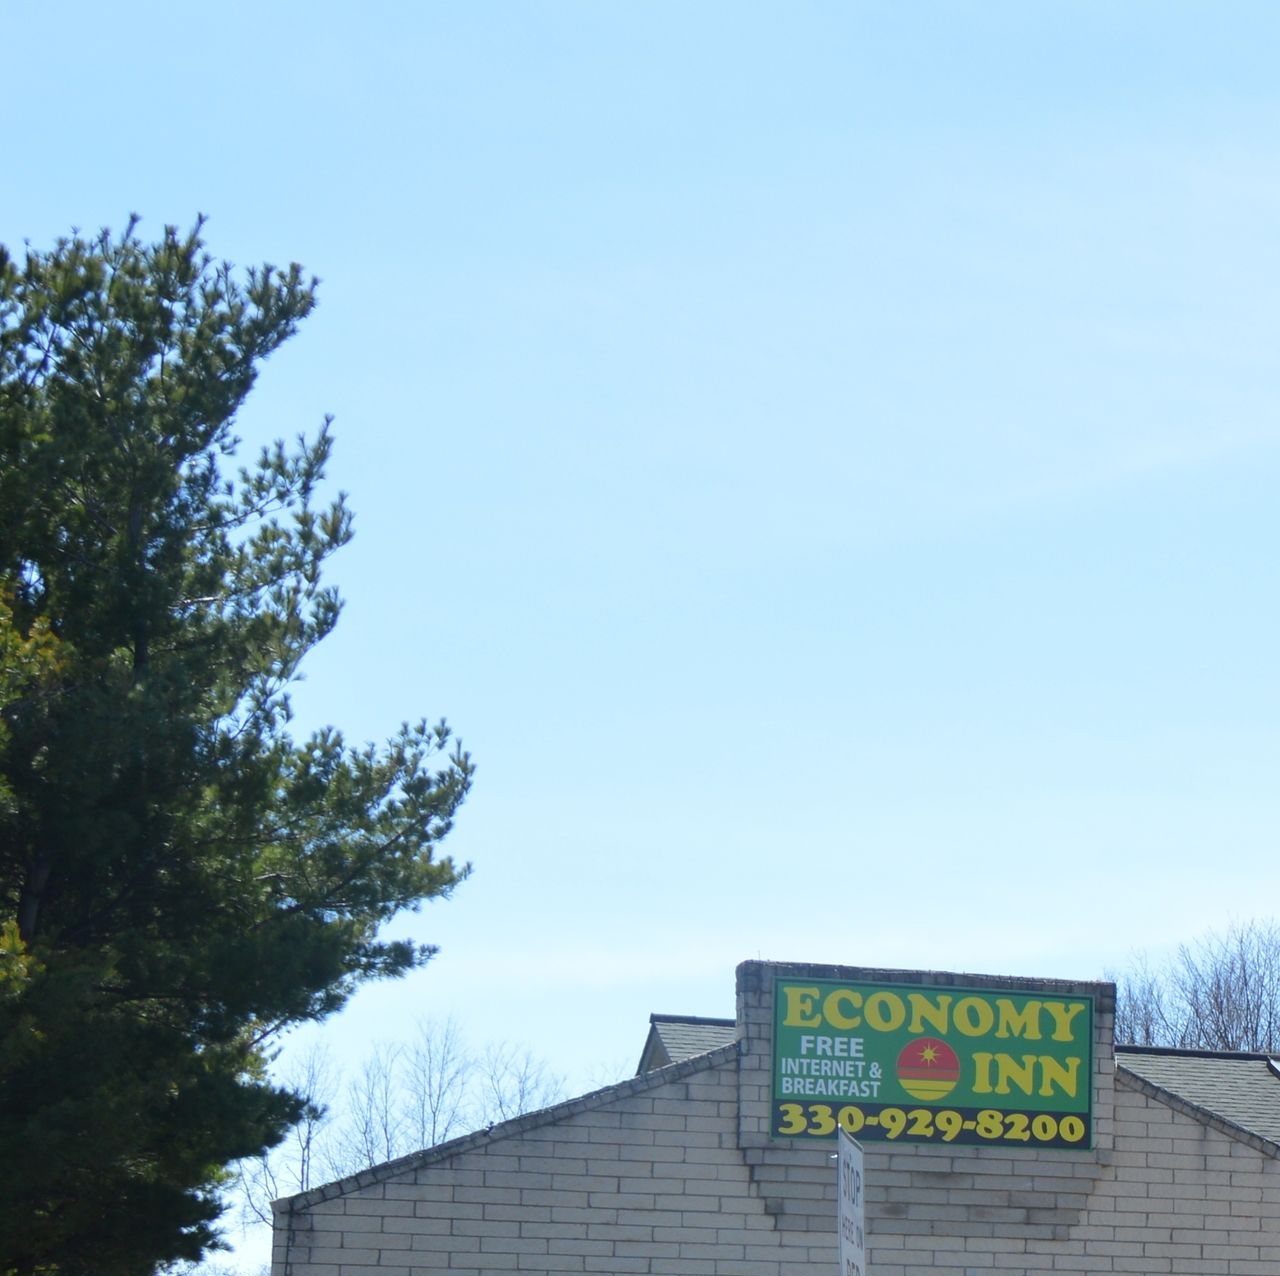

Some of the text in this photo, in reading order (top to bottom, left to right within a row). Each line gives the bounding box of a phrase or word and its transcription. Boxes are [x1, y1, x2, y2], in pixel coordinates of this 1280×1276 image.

[782, 987, 1086, 1041] ECONOMY
[800, 1035, 864, 1058] FREE
[781, 1058, 882, 1079] INTERNET &
[782, 1077, 881, 1098] BREAKFAST
[972, 1052, 1081, 1098] INN
[778, 1103, 1085, 1142] 330-929-8200
[843, 1159, 861, 1208] STOP
